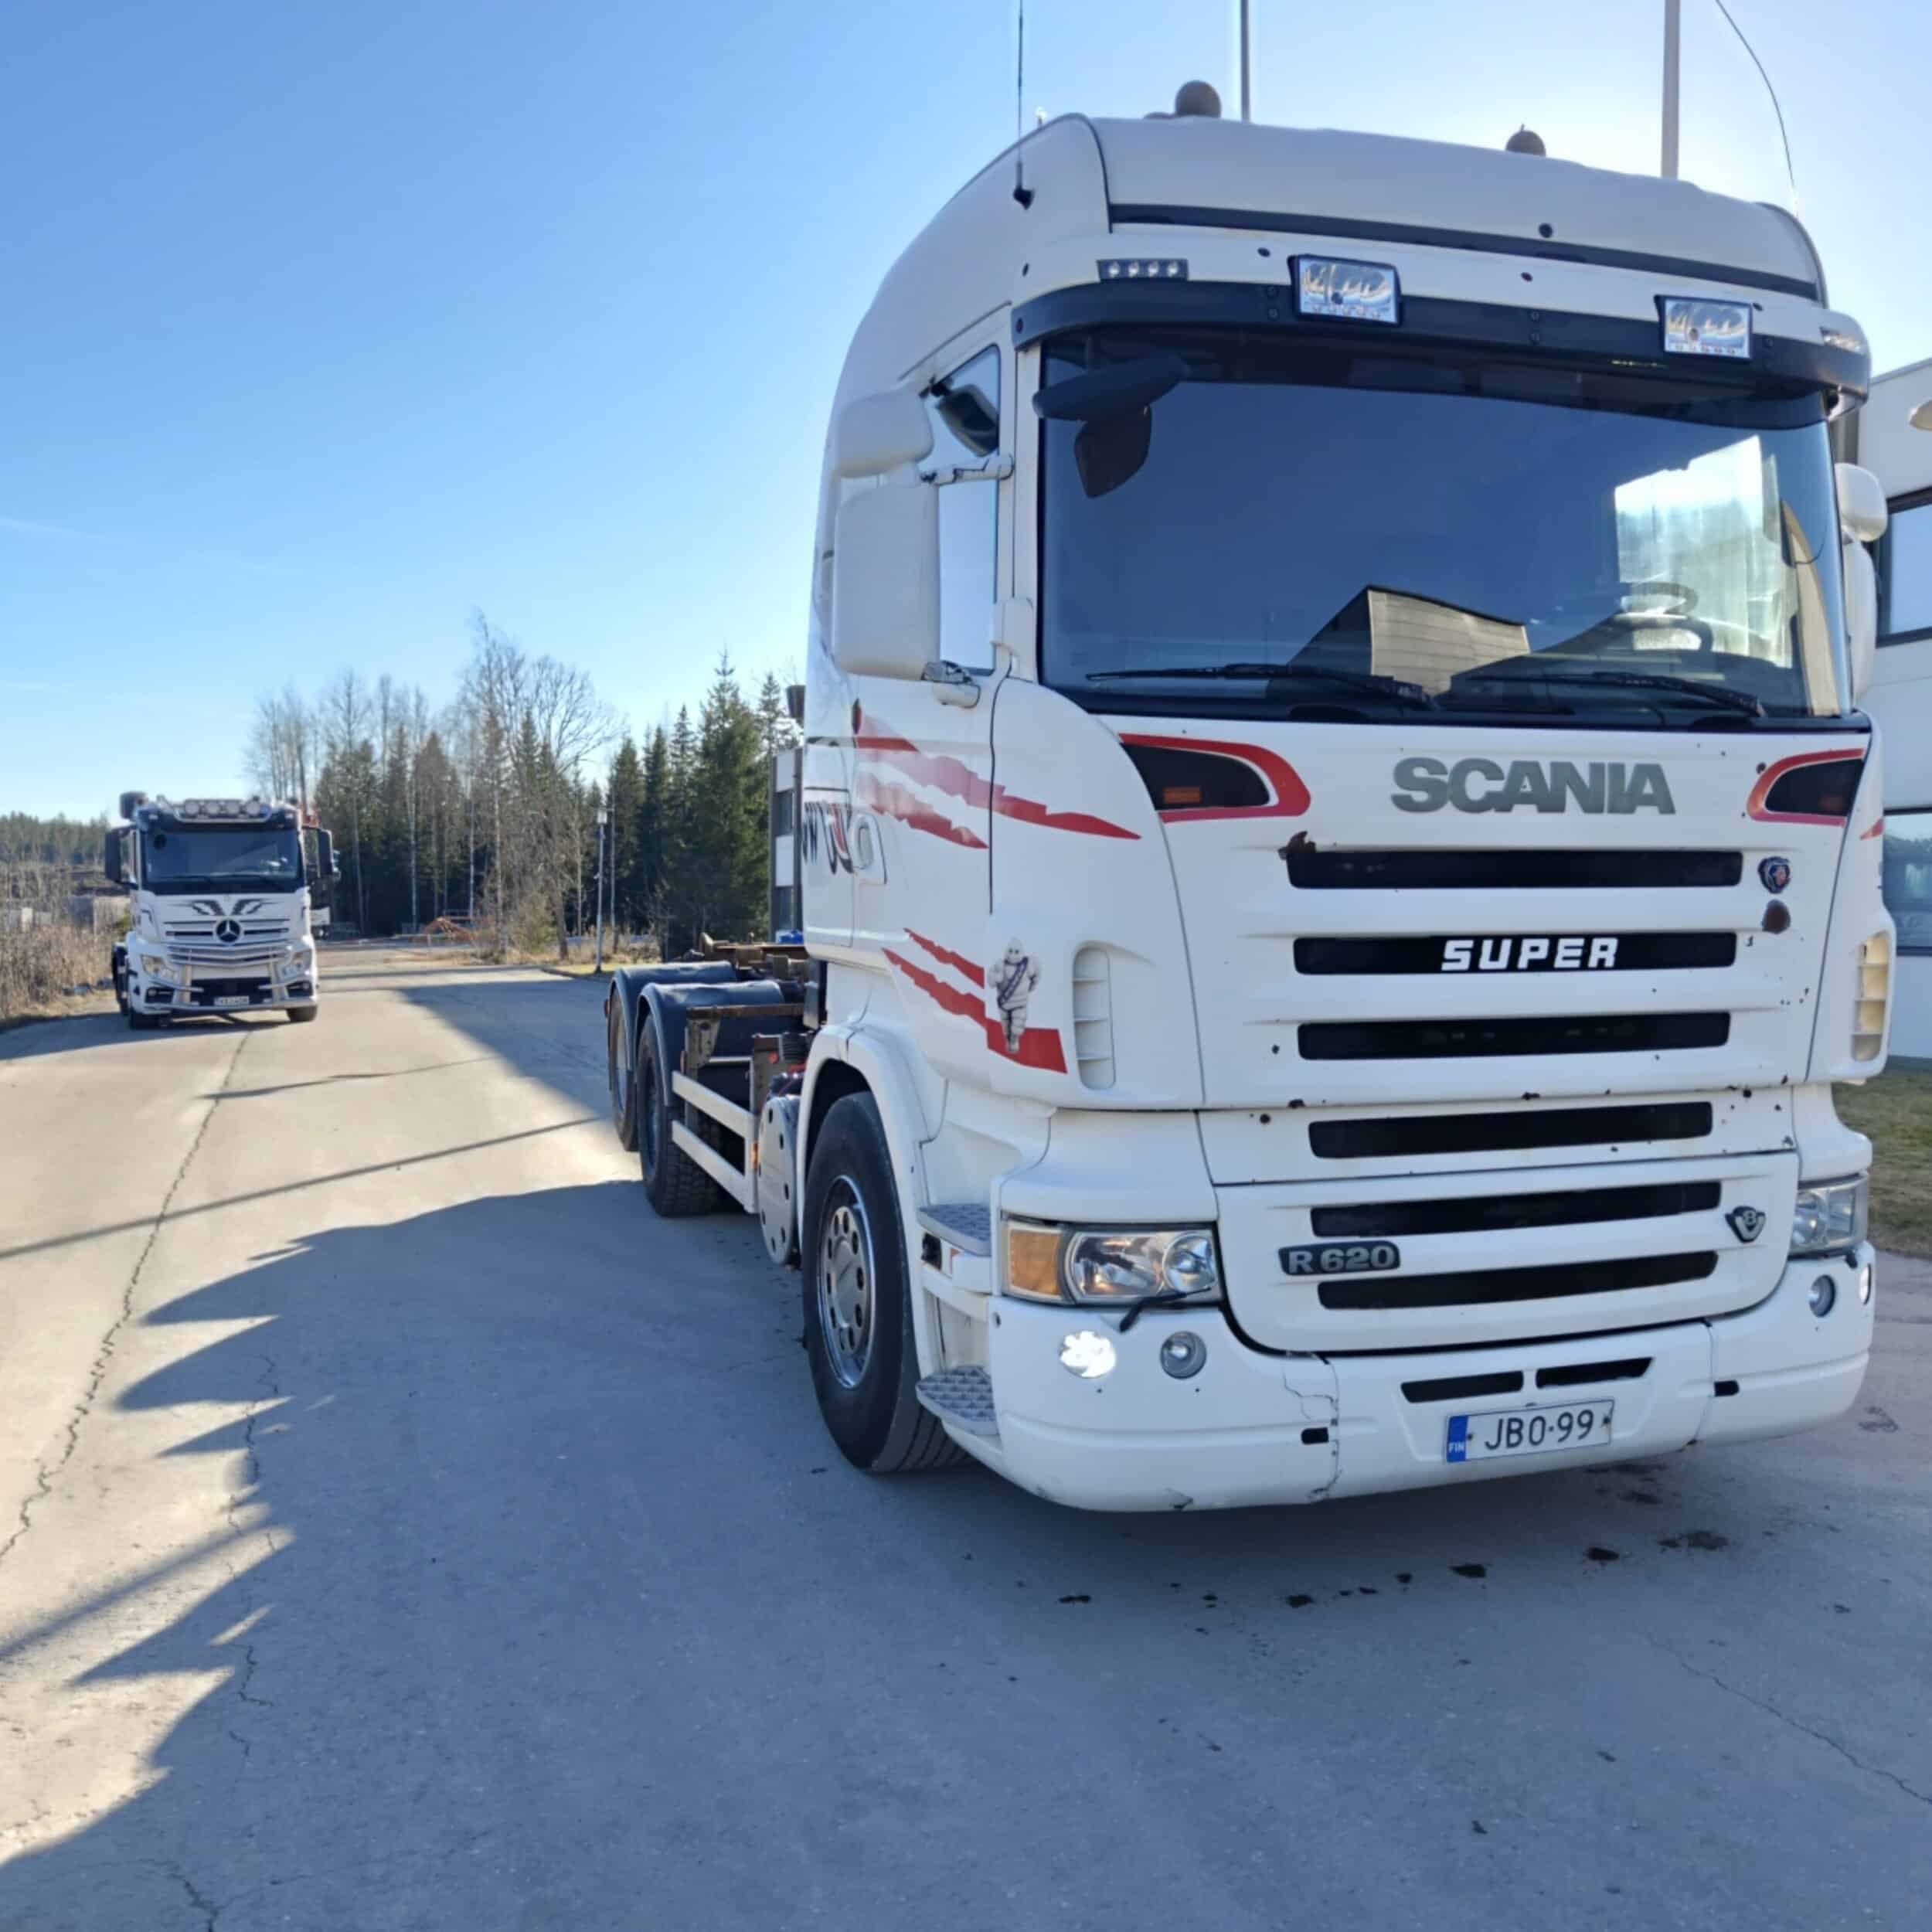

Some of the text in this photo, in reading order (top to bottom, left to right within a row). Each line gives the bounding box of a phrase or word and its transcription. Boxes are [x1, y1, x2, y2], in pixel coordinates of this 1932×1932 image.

[1392, 757, 1675, 815] SCANIA
[1441, 937, 1618, 971] SUPER
[1288, 1245, 1395, 1274] R 620
[1449, 1441, 1464, 1453] FIN
